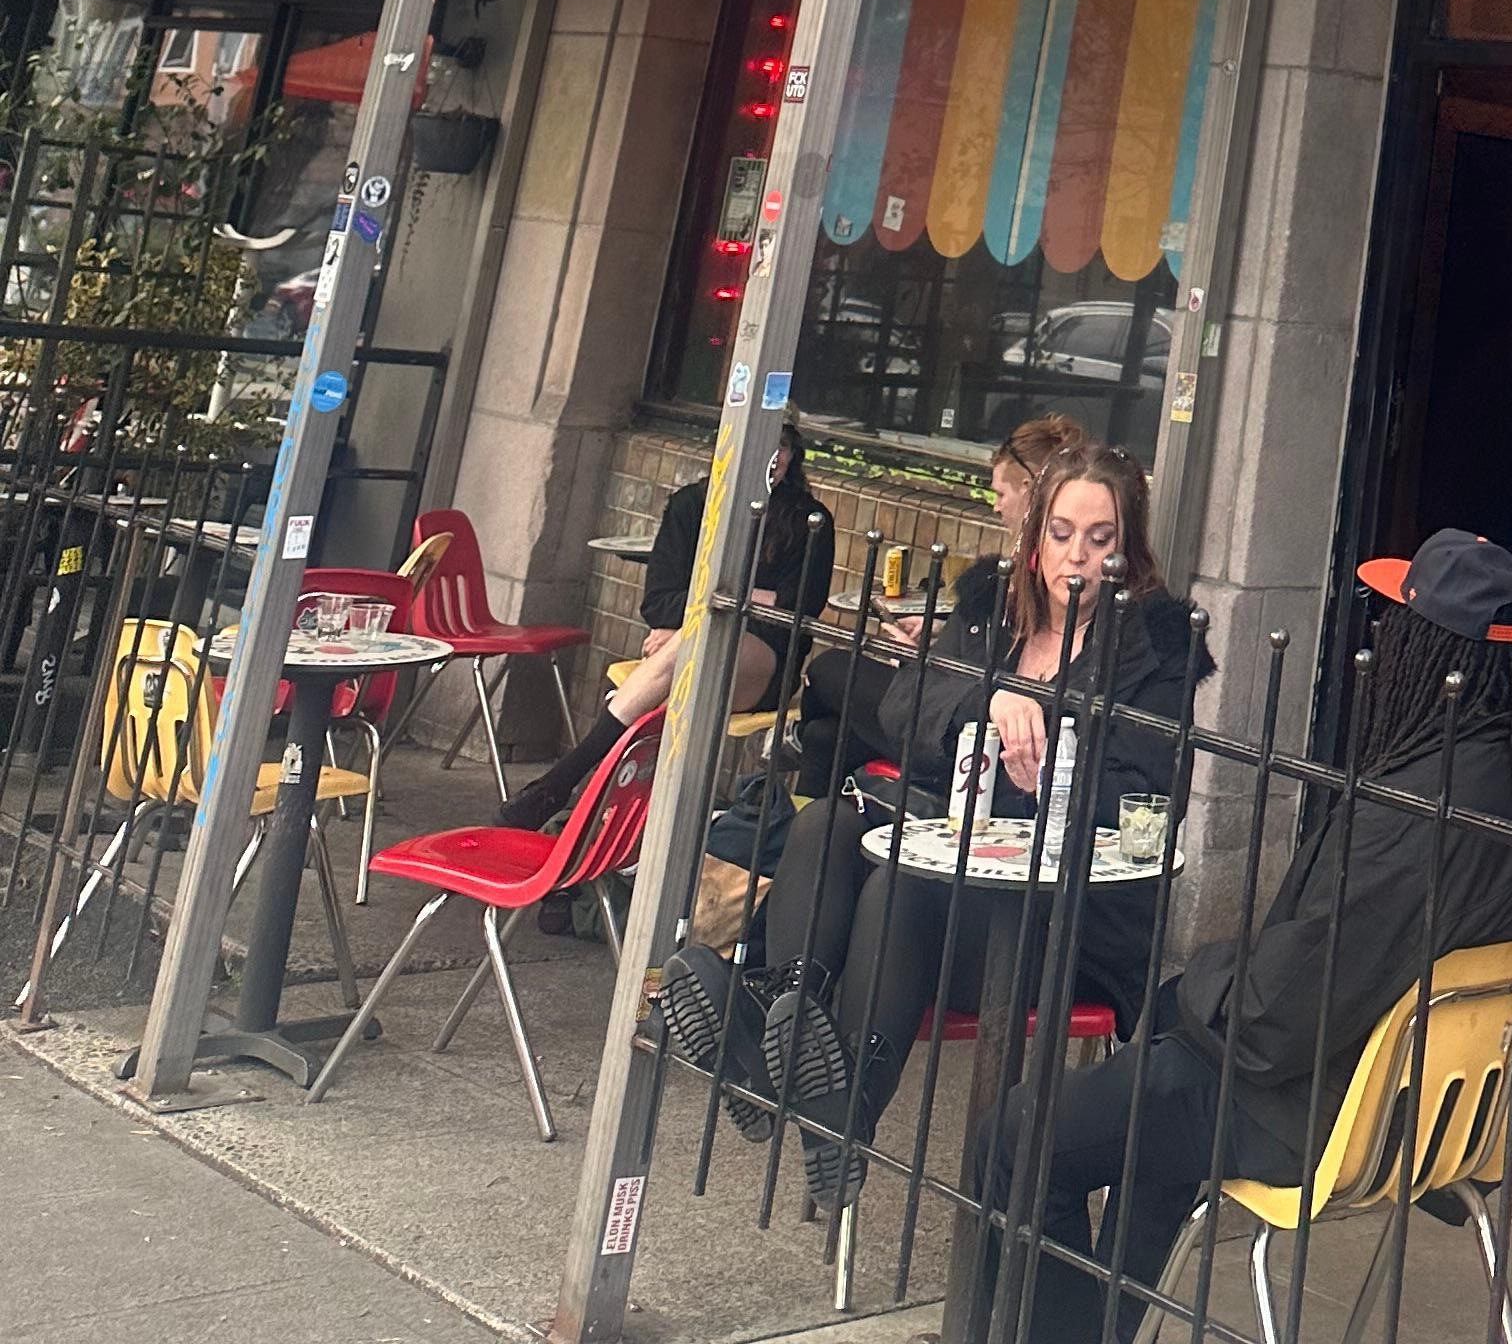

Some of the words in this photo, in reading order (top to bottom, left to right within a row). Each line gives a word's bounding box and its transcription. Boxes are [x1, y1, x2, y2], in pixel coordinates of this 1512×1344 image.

[613, 1182, 629, 1216] MUSK
[617, 1207, 635, 1251] DRINKS
[627, 1178, 641, 1205] PISS
[607, 1220, 620, 1250] ELON
